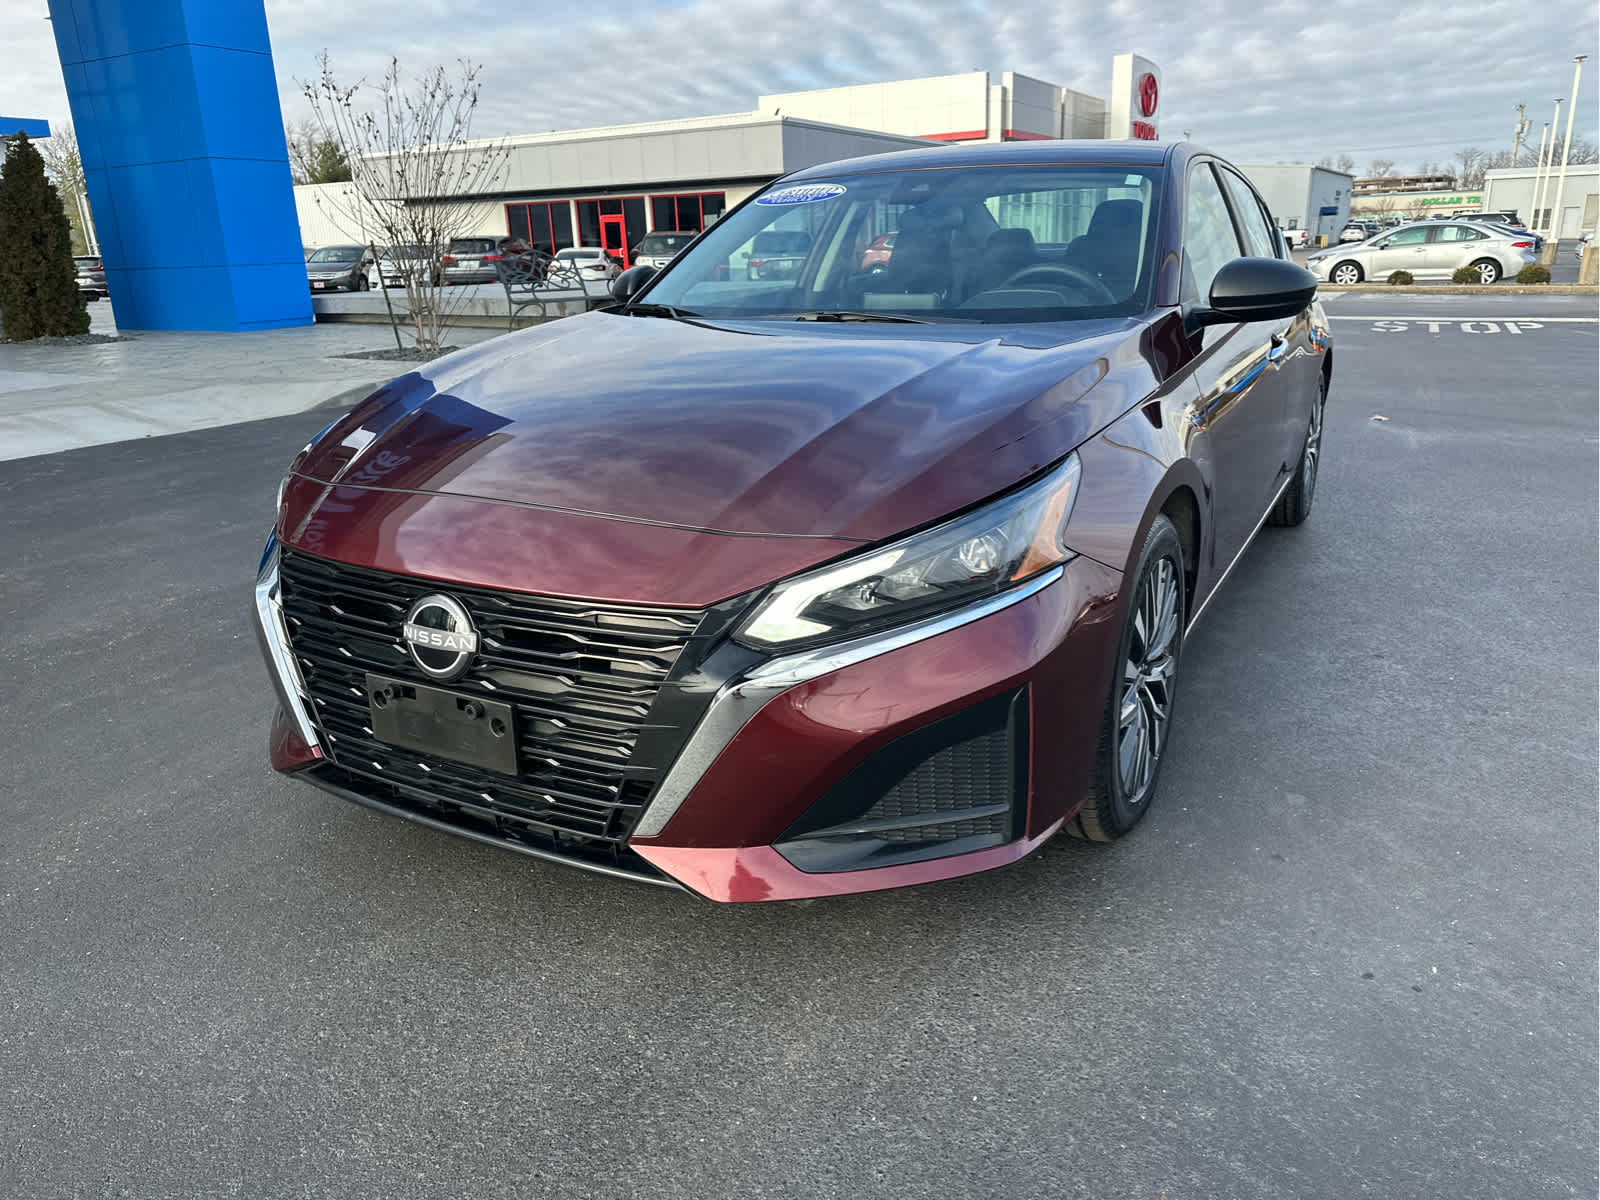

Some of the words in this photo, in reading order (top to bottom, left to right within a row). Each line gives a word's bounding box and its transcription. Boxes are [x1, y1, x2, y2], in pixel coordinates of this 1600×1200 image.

[1421, 196, 1463, 206] DOLLAR
[1370, 320, 1545, 334] STOP
[403, 626, 476, 650] NISSAN
